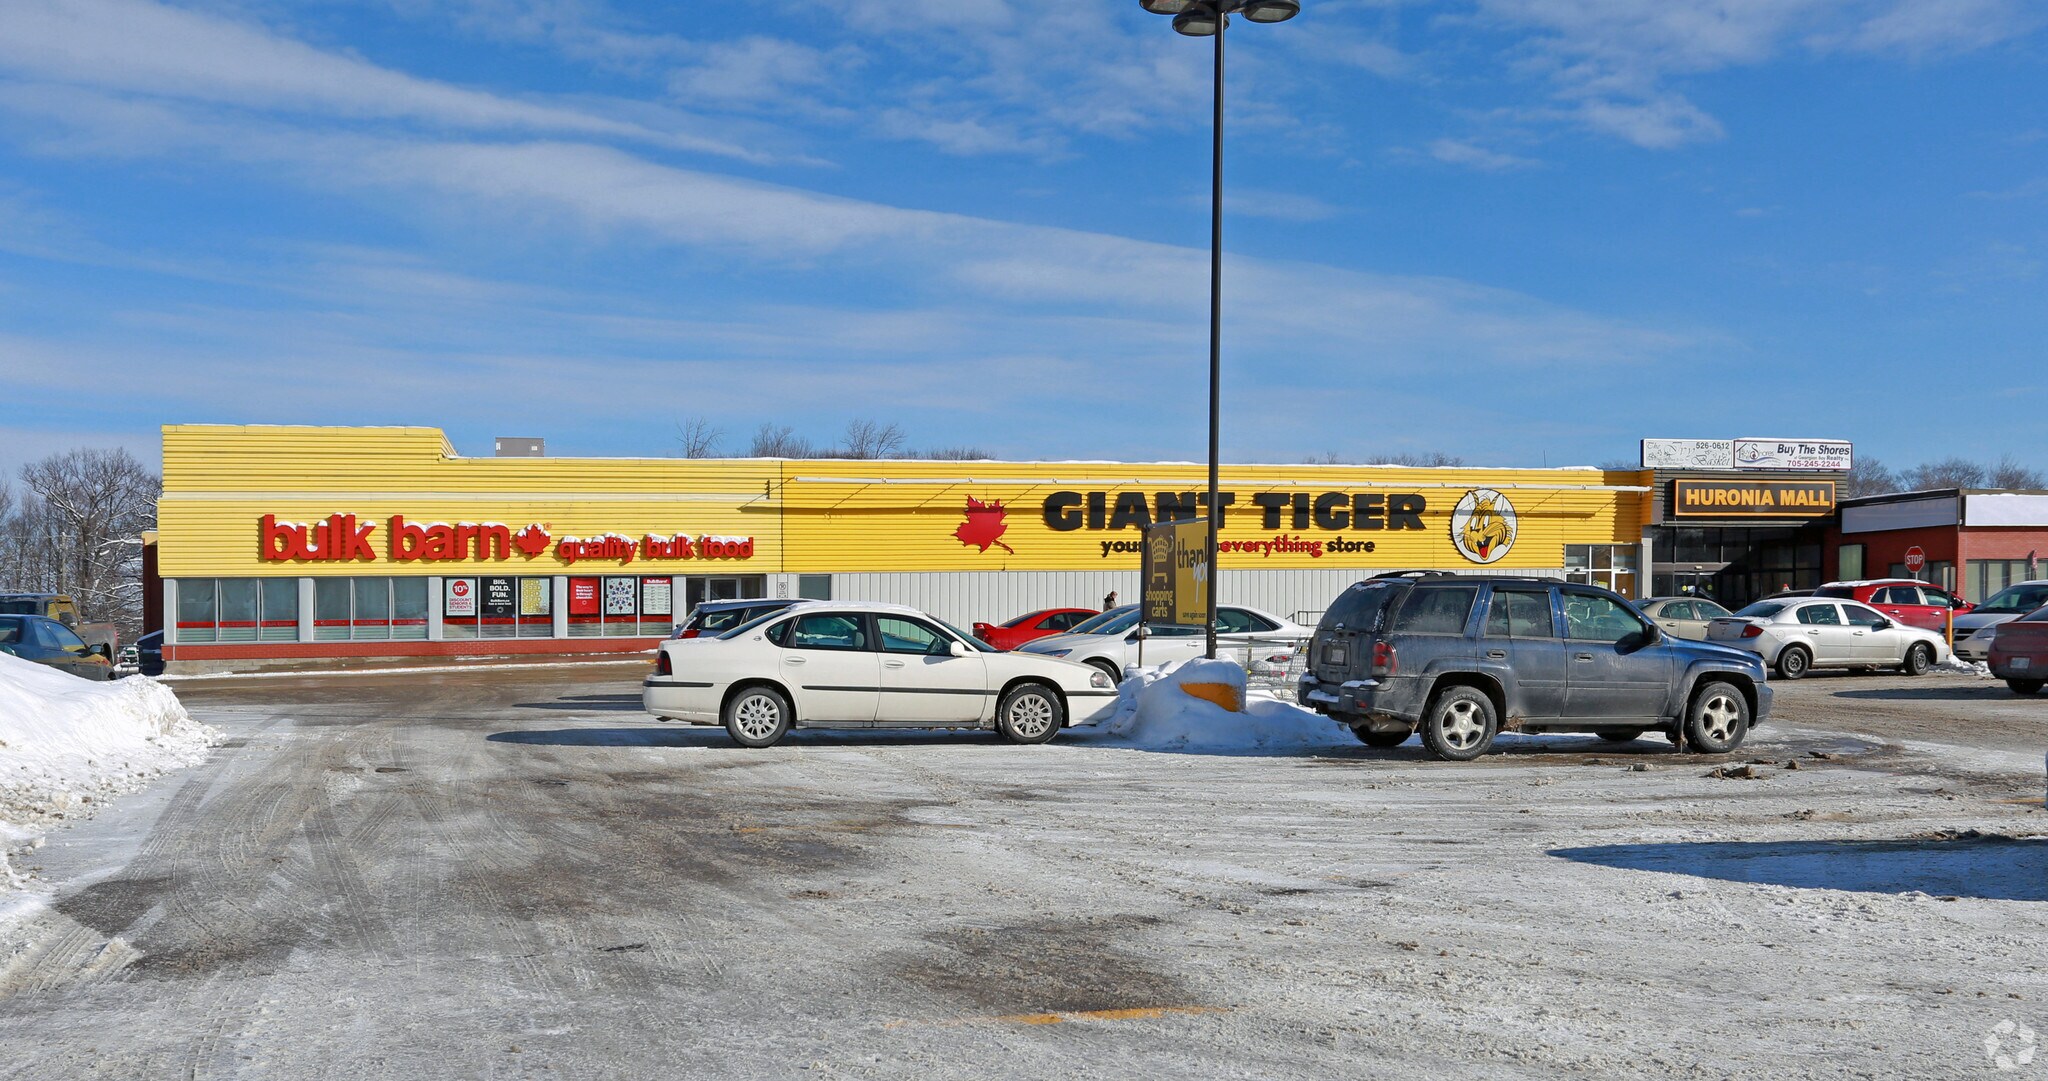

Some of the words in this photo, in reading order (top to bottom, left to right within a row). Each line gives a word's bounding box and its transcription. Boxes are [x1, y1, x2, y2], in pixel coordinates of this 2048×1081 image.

[1695, 441, 1730, 450] 526-0612
[1777, 444, 1796, 456] Buy
[1798, 444, 1816, 455] The
[1818, 444, 1850, 455] Shores
[1685, 488, 1775, 506] HURONIA
[1779, 489, 1830, 506] MALL
[1044, 491, 1235, 531] GIANT
[1254, 491, 1426, 530] TIGER
[263, 513, 377, 560] bulk
[391, 514, 511, 560] barn
[1219, 534, 1323, 558] everything
[1327, 536, 1376, 552] store
[559, 533, 639, 563] quality
[645, 534, 696, 558] bulk
[701, 535, 754, 558] food
[1906, 554, 1923, 565] STOP
[1145, 584, 1173, 606] shopping
[1152, 601, 1168, 617] carts
